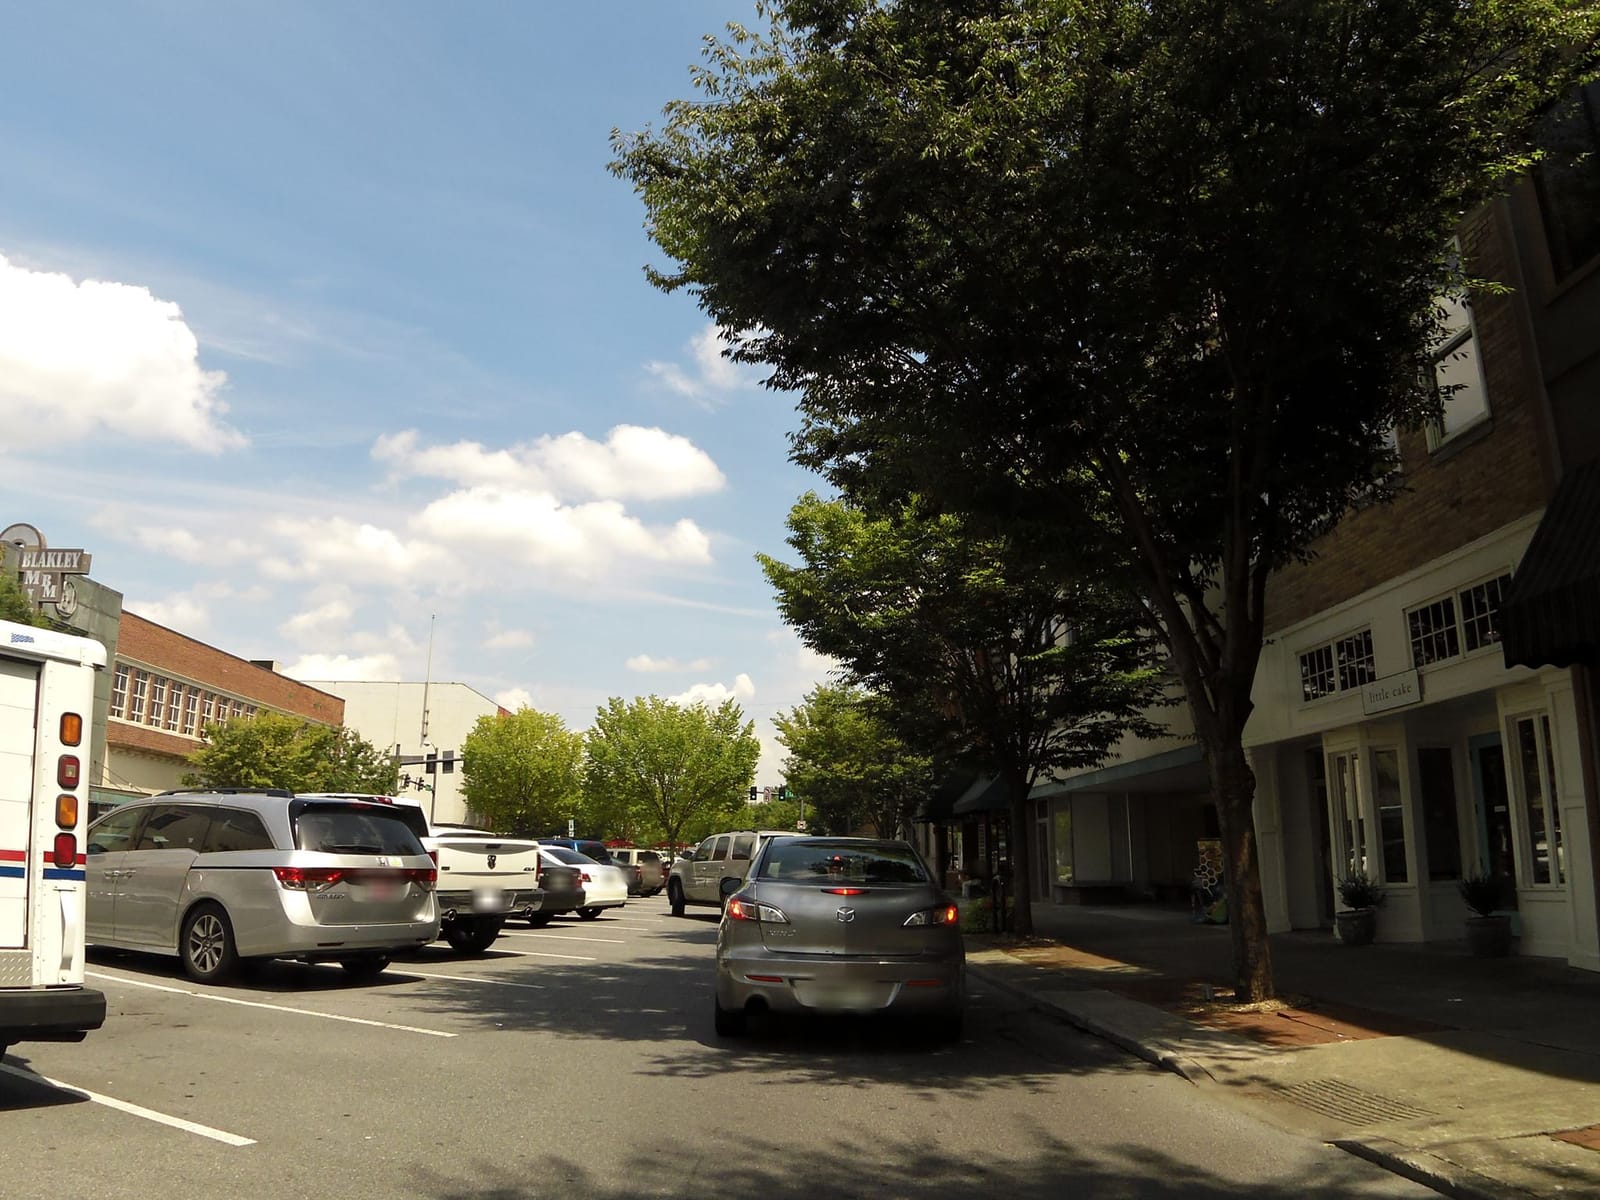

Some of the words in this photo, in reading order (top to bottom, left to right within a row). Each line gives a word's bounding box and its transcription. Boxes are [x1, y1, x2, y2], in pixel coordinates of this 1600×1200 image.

[21, 551, 81, 568] BLAKLEY
[1368, 687, 1389, 704] little
[1392, 683, 1412, 697] cake
